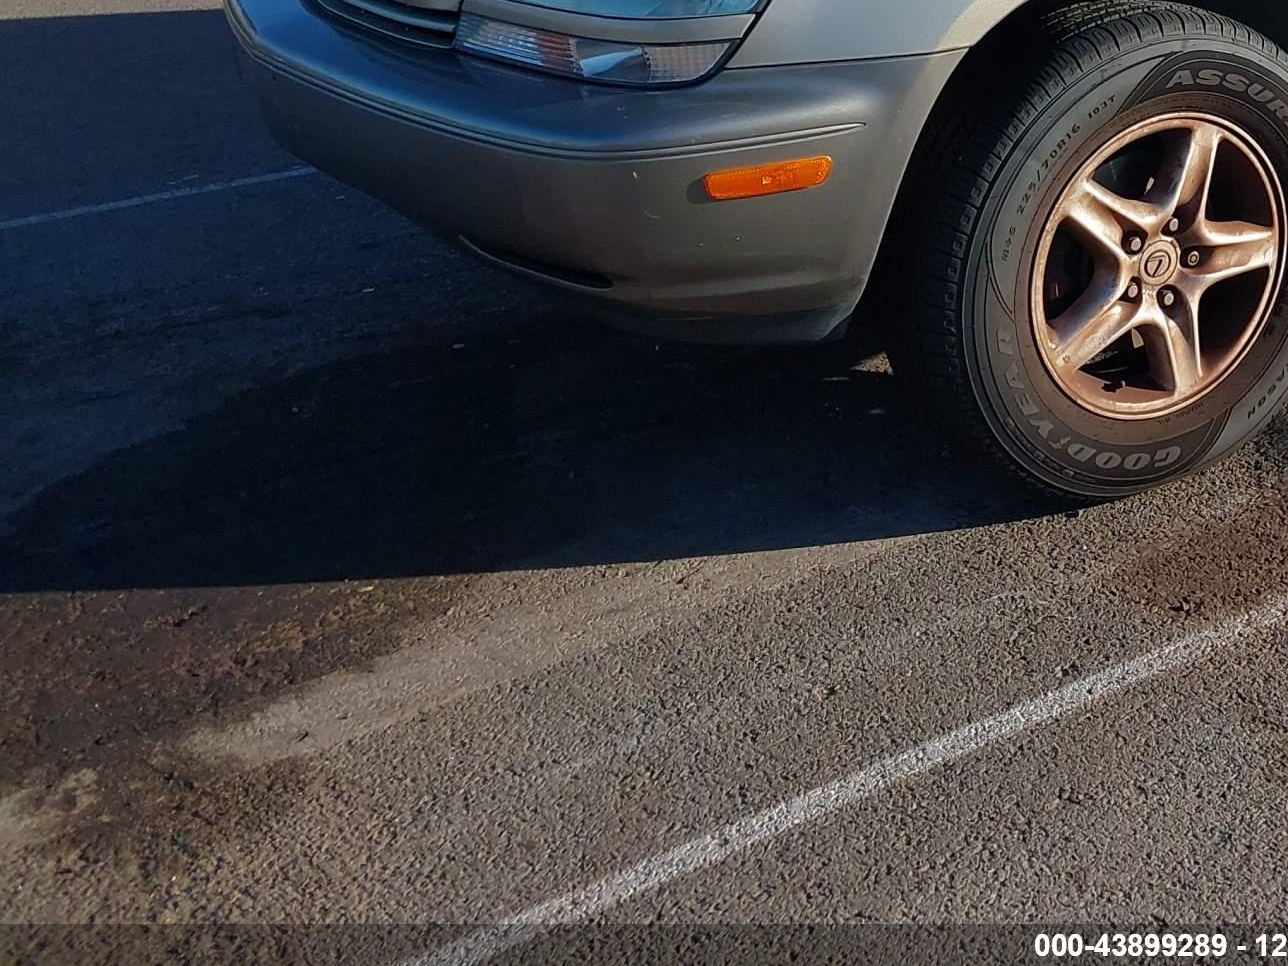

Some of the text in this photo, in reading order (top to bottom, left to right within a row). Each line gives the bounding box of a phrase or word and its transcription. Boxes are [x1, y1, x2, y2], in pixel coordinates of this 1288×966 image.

[1016, 123, 1082, 216] 225/70R16
[1087, 94, 1117, 120] 103T
[996, 328, 1182, 471] GOODYEAR
